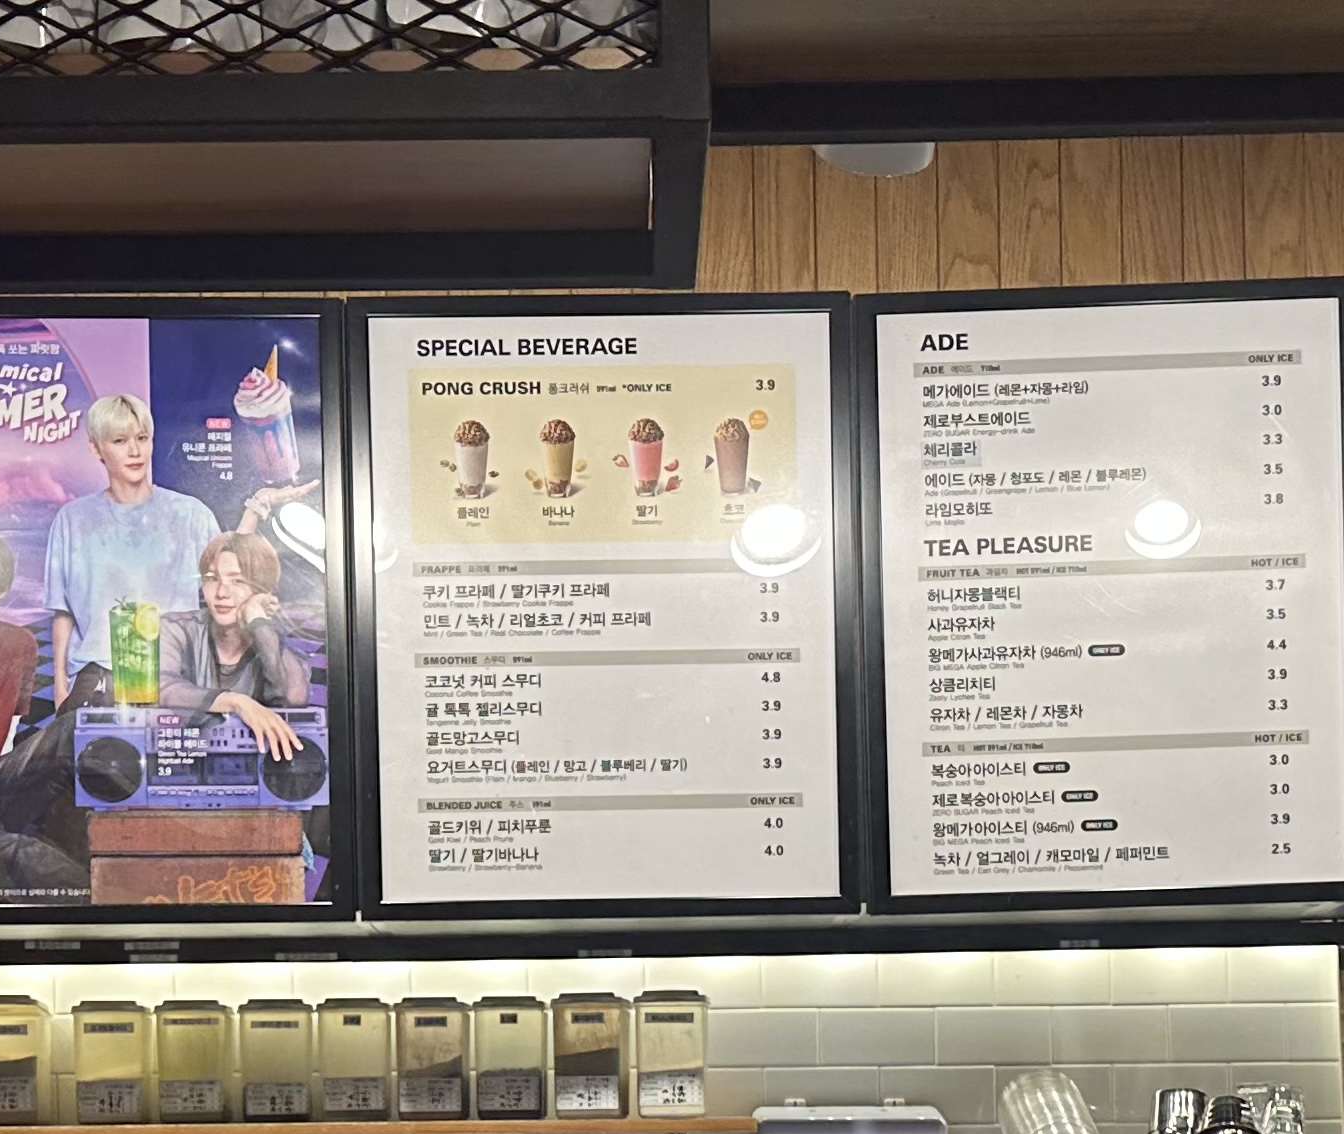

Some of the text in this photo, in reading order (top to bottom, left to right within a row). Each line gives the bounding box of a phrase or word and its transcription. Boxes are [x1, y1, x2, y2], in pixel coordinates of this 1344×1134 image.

[417, 338, 637, 356] SPECIAL BEVERAGE
[921, 334, 968, 351] ADE
[1248, 354, 1293, 363] ONLY ICE
[422, 382, 473, 395] PONG
[480, 382, 540, 394] CRUSH
[548, 383, 589, 395] 퐁크러쉬
[656, 384, 671, 392] ICE
[756, 379, 775, 390] 3.9
[923, 384, 990, 399] 메가에이드
[1262, 375, 1281, 386] 3.9
[923, 405, 1282, 428] 제로부스트에이드 3.0
[24, 410, 81, 444] NIGHT
[924, 434, 1282, 457] 체리콜라 3.3
[457, 507, 489, 519] 플레인
[543, 506, 575, 518] 바나나
[636, 505, 657, 517] 딸기
[926, 493, 1283, 517] 라임모히또 3.8
[924, 535, 1092, 556] TEA PLEASURE
[927, 579, 1285, 603] 허니자몽블랙티 3.7
[928, 609, 1286, 632] 사과유자차 3.5
[748, 652, 792, 660] ONLY ICE
[929, 639, 1286, 663] 왕메가사과유자차 (946ml) 4.4
[424, 656, 477, 665] SMOOTHIE
[425, 672, 780, 689] 코코넛 커피 스무디 4.8
[929, 669, 1287, 693] 상큼리치티 3.9
[426, 704, 439, 717] 귤
[476, 702, 541, 716] 젤리스무디
[762, 701, 781, 711] 3.9
[426, 729, 781, 746] 골드망고스무디 3.9
[931, 754, 1289, 778] 복숭아아이스티 3.0
[932, 784, 1289, 807] 제로복숭아아이스티 3.0
[426, 801, 502, 810] BLENDED JUICE
[428, 820, 481, 835] 골드키위
[933, 813, 1290, 838] 왕메가아이스티 (946ml) 3.9
